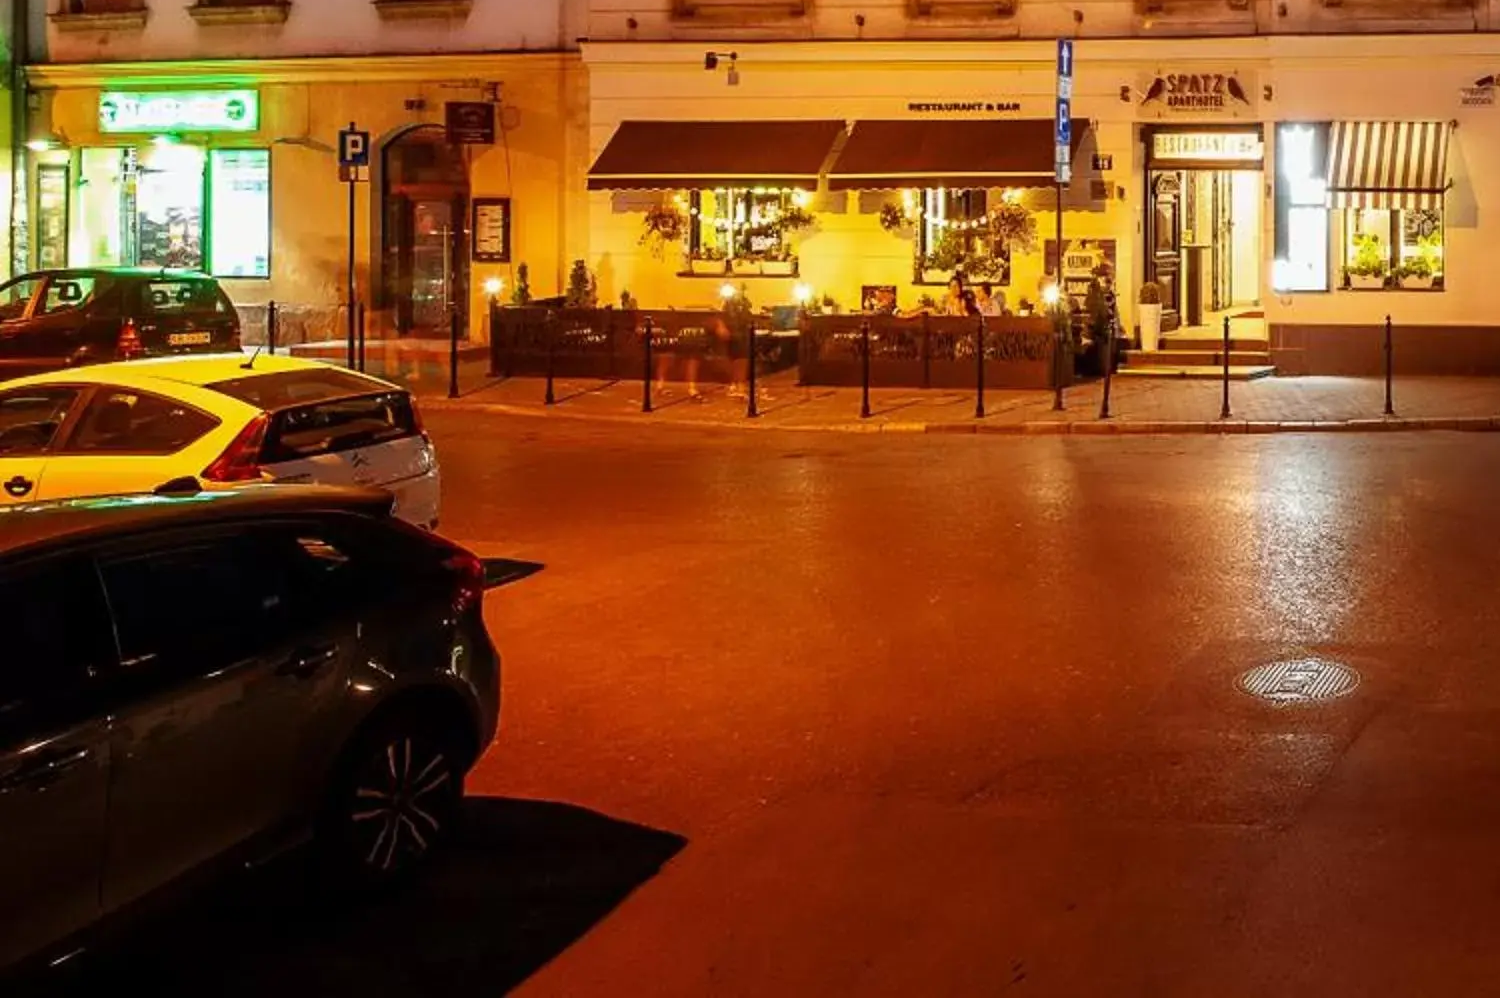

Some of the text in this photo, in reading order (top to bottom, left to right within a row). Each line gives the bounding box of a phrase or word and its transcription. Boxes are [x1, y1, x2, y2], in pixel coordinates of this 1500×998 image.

[1167, 74, 1225, 93] SPATZ
[908, 102, 982, 111] RESTAURANT
[1167, 96, 1224, 106] APARTHOTEL
[345, 134, 363, 161] P
